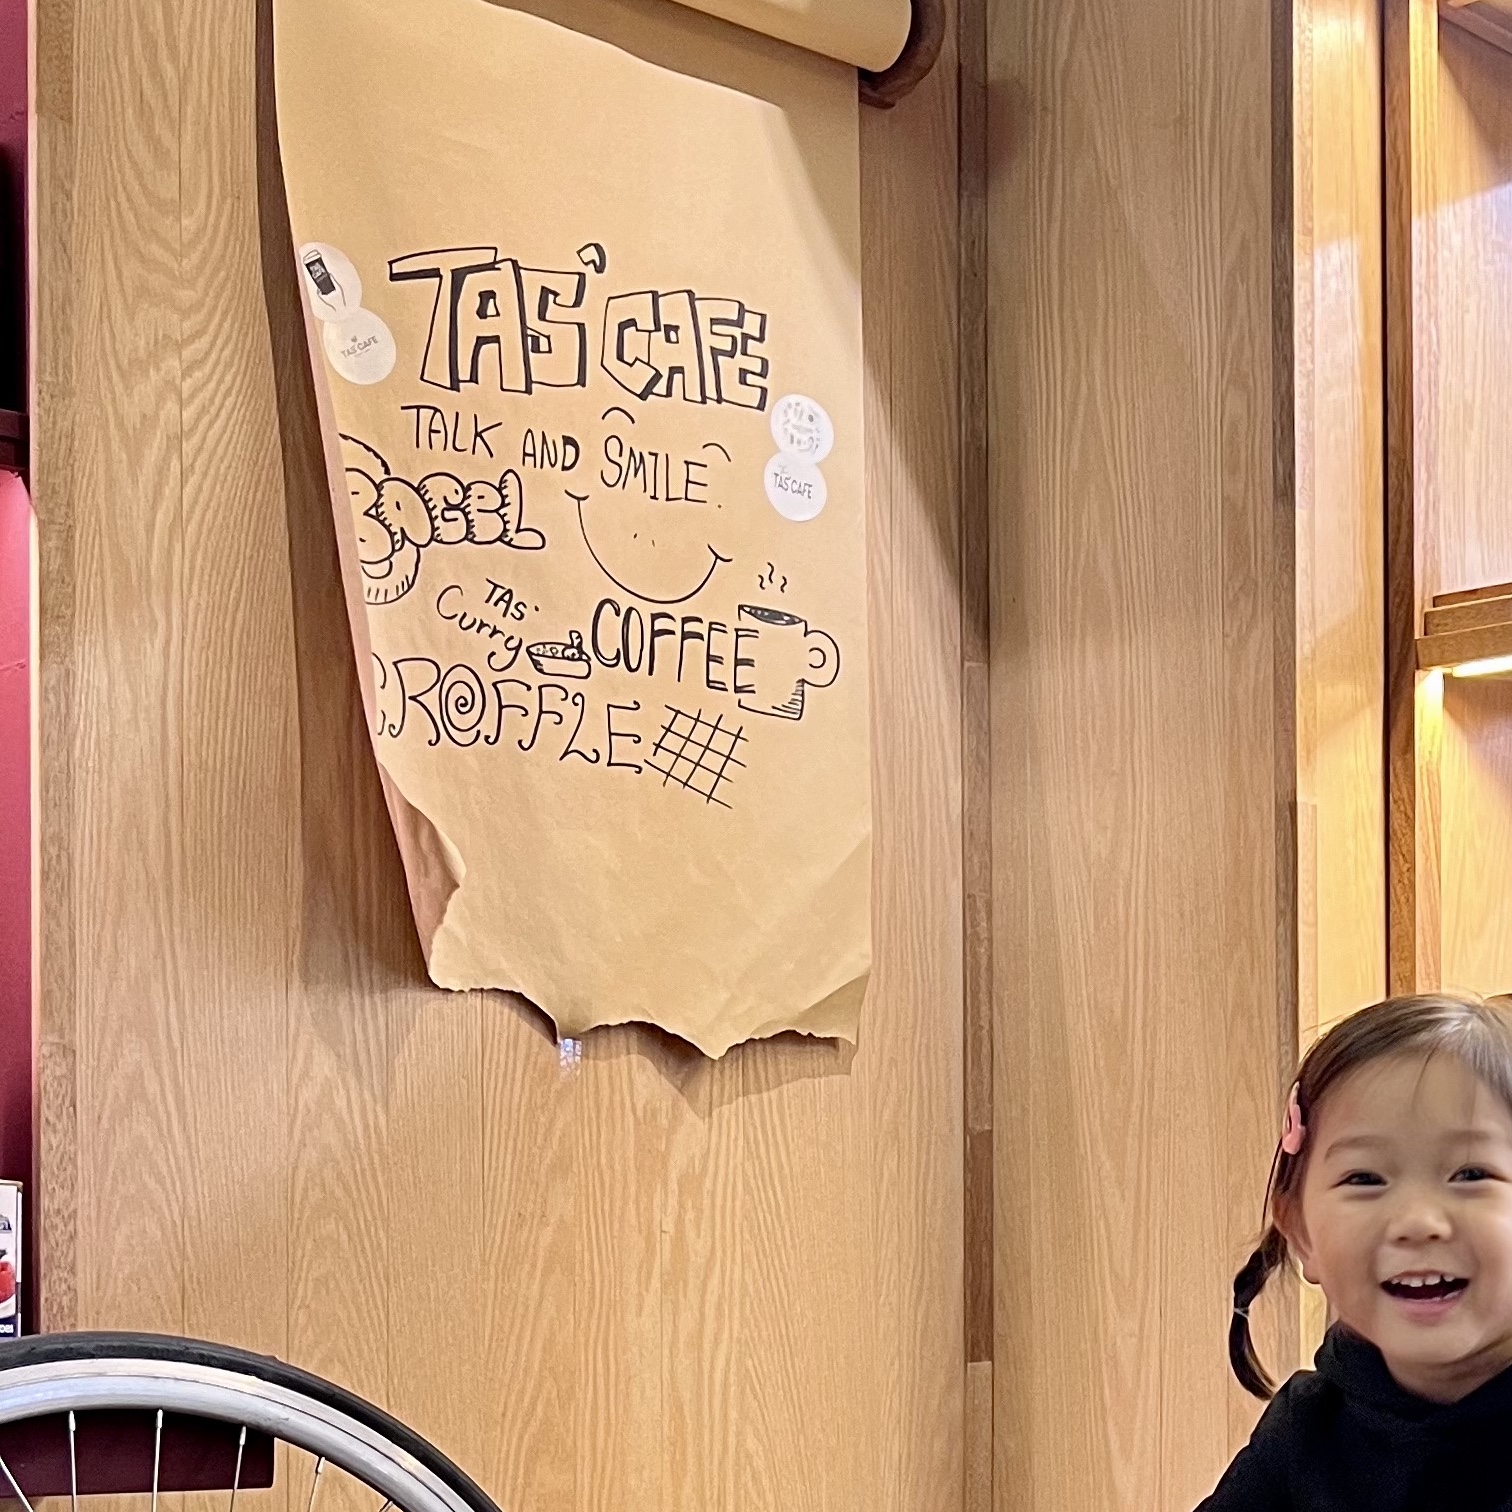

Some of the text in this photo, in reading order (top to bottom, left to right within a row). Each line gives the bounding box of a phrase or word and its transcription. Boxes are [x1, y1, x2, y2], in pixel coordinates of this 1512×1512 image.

[601, 290, 769, 411] CAFE
[401, 405, 502, 458] TALK
[523, 428, 580, 472] AND
[791, 479, 813, 500] CAFE
[436, 584, 523, 673] Curry
[591, 598, 759, 694] COFFEE
